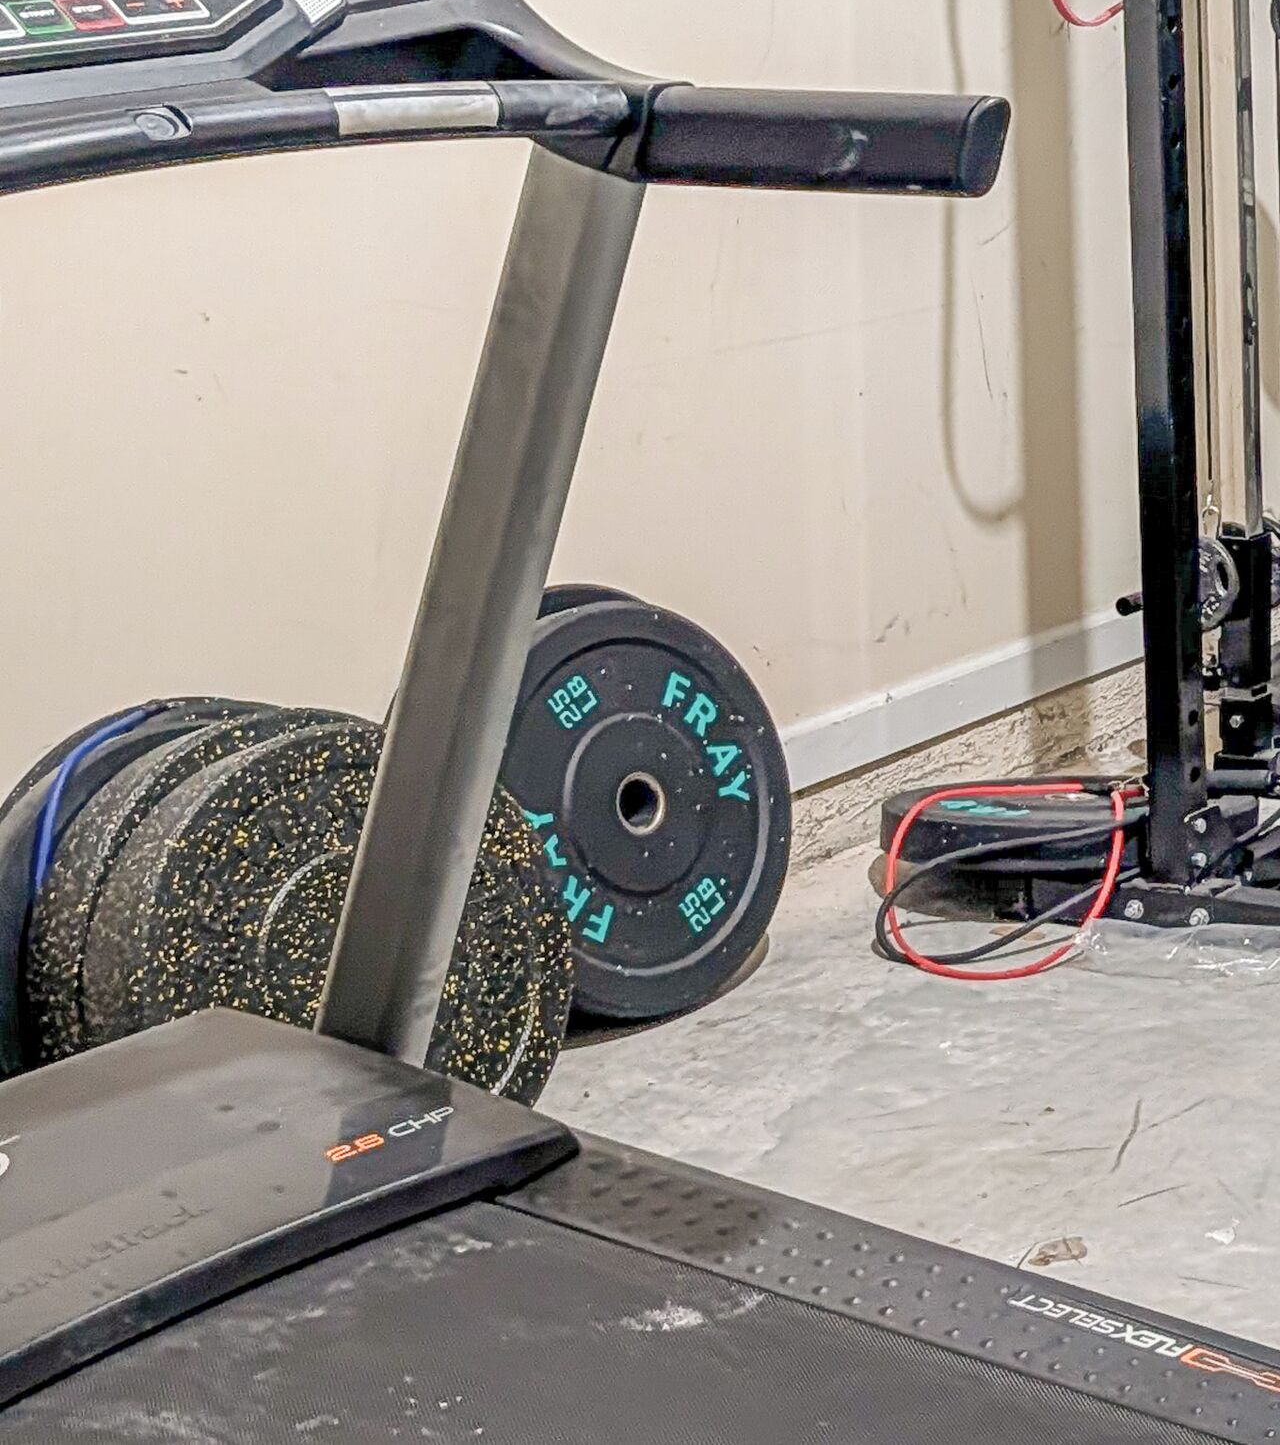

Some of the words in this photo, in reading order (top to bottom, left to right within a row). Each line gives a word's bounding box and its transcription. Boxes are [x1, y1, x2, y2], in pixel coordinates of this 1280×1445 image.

[19, 7, 55, 19] START
[71, 3, 103, 14] STOP
[547, 692, 582, 729] 25
[567, 674, 599, 714] LB
[661, 671, 750, 803] FRAY
[679, 896, 711, 933] 25
[699, 877, 728, 916] LB
[387, 1106, 455, 1137] CHP
[1009, 1294, 1194, 1358] FLEXSELECT
